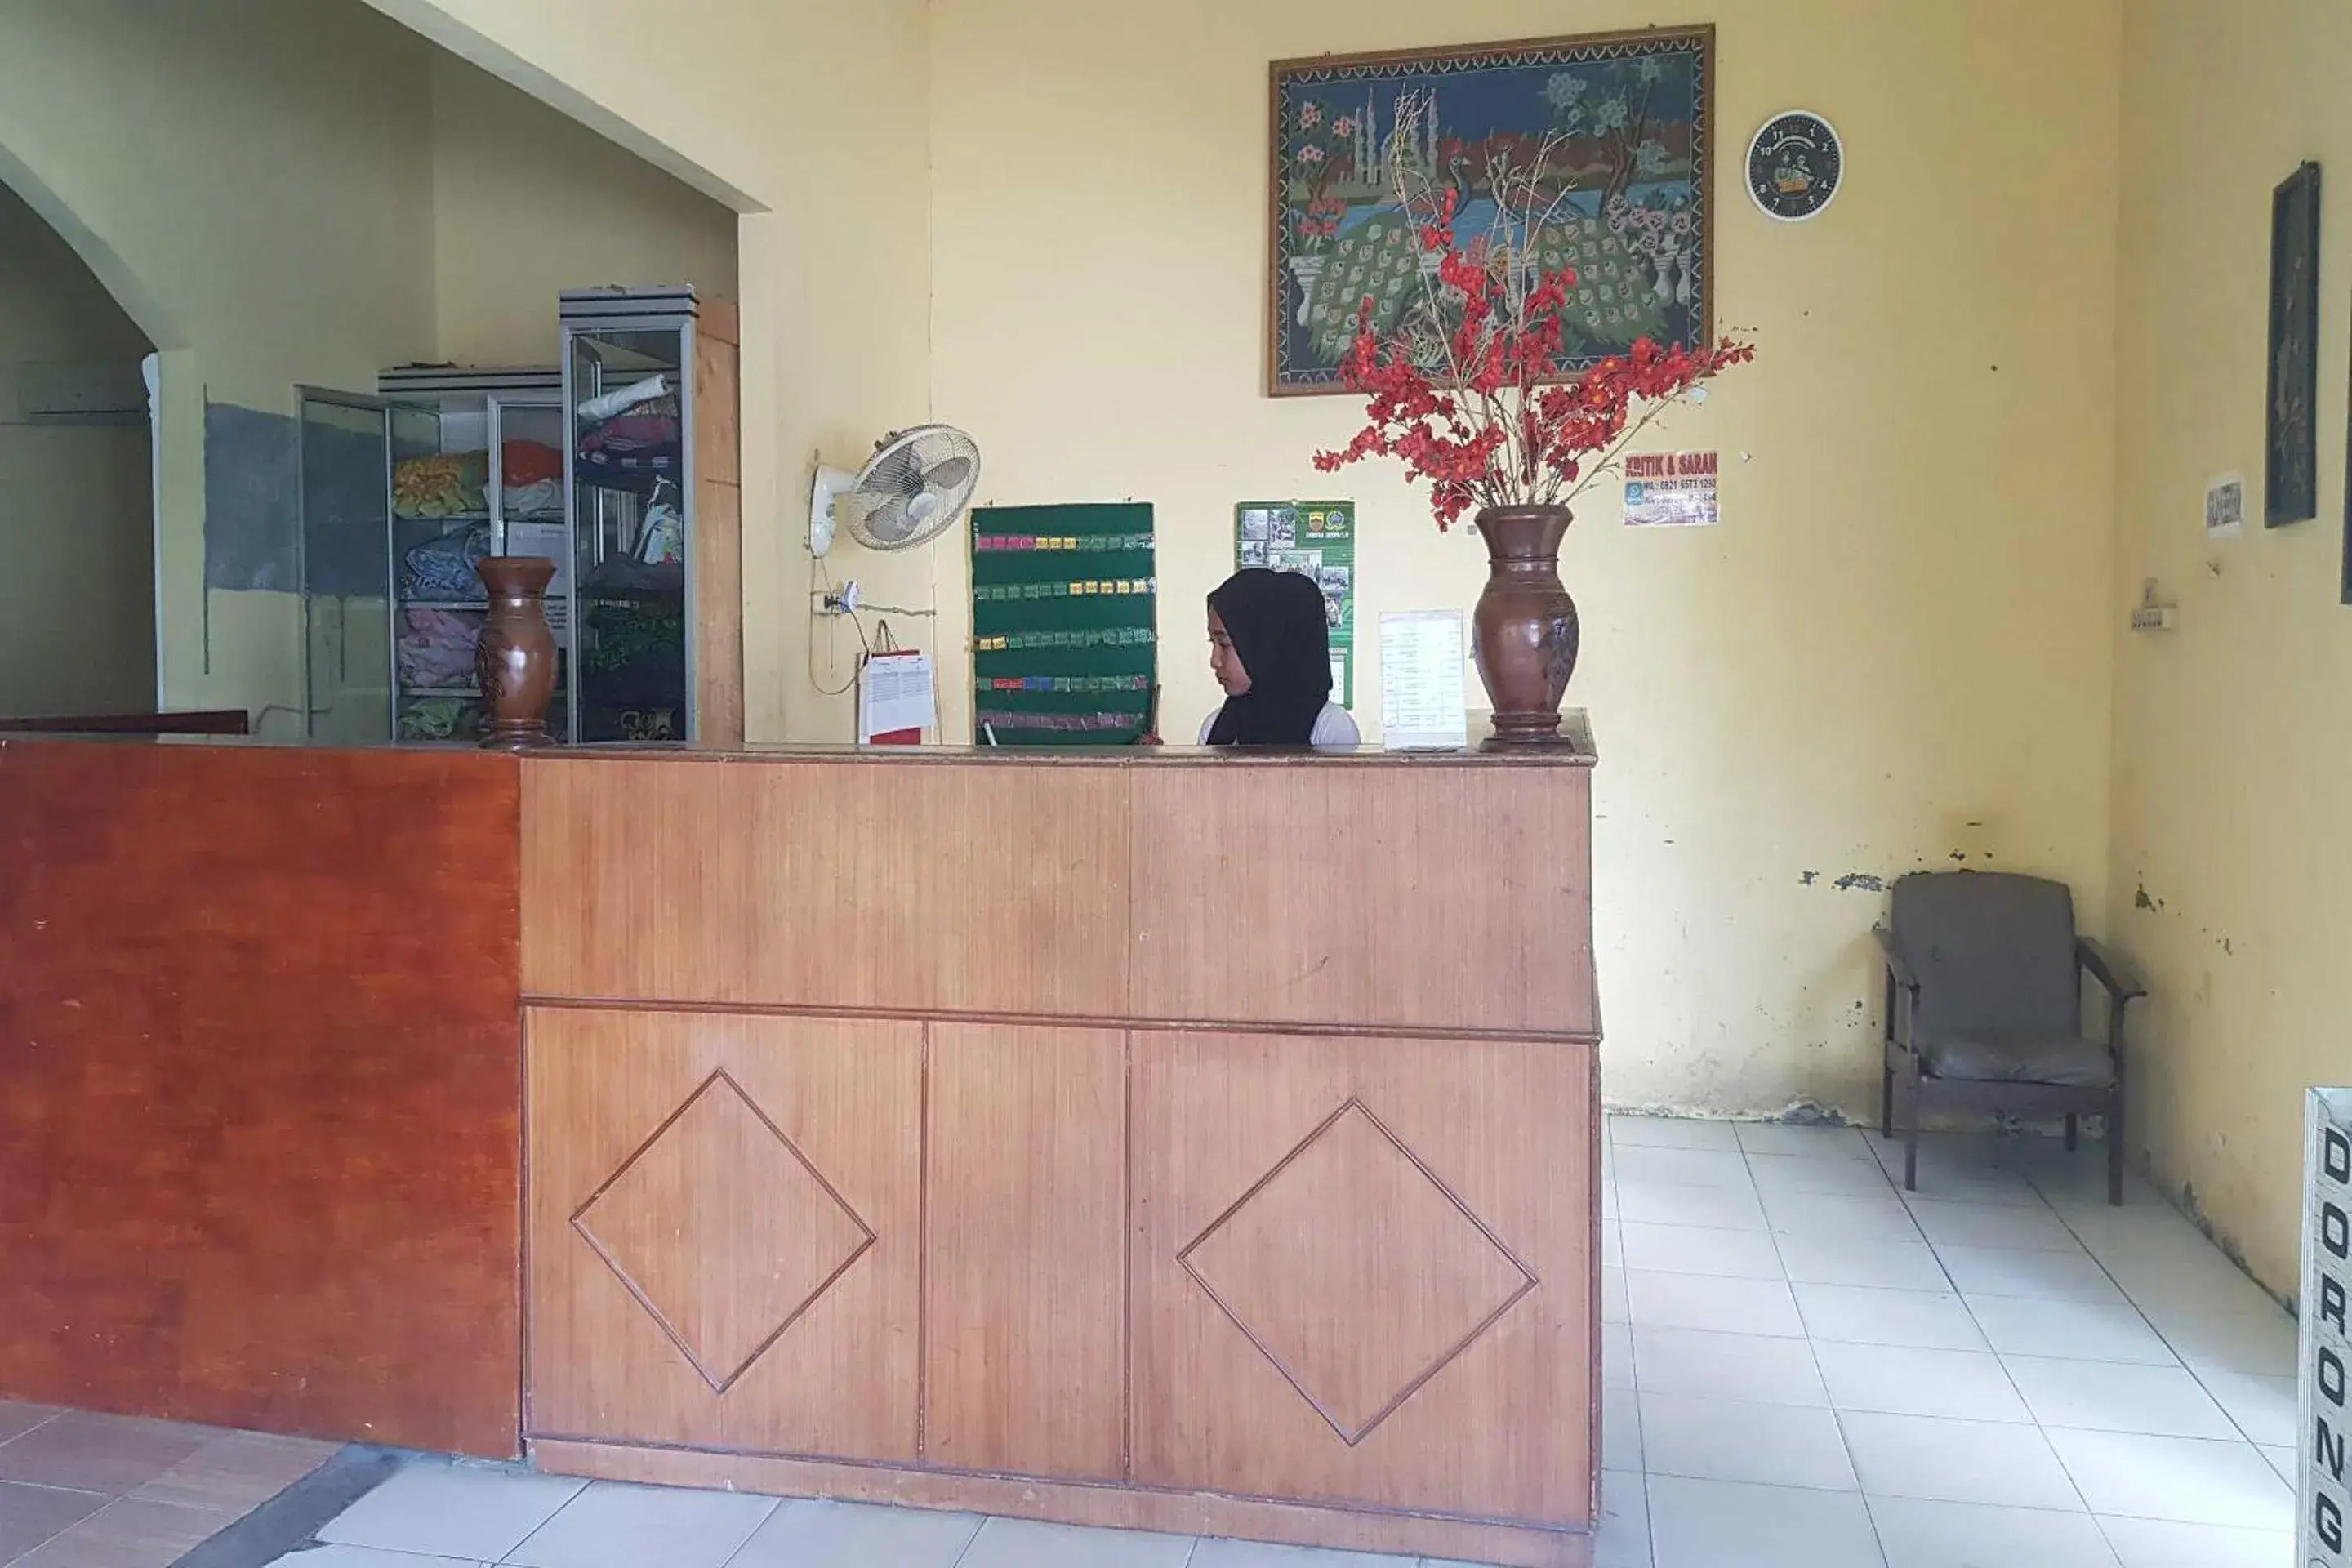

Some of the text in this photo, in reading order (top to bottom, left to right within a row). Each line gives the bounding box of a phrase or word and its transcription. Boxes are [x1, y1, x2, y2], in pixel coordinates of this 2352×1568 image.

[1773, 131, 1784, 140] 11
[1808, 128, 1815, 136] 1
[1761, 147, 1771, 156] 10
[1822, 143, 1829, 151] 2
[1760, 185, 1766, 193] 8
[1820, 180, 1828, 189] 4
[1772, 198, 1780, 207] 7
[1808, 195, 1814, 204] 5
[1667, 455, 1675, 476] &
[1679, 452, 1717, 475] SARAN
[2316, 1127, 2350, 1554] DORONG
